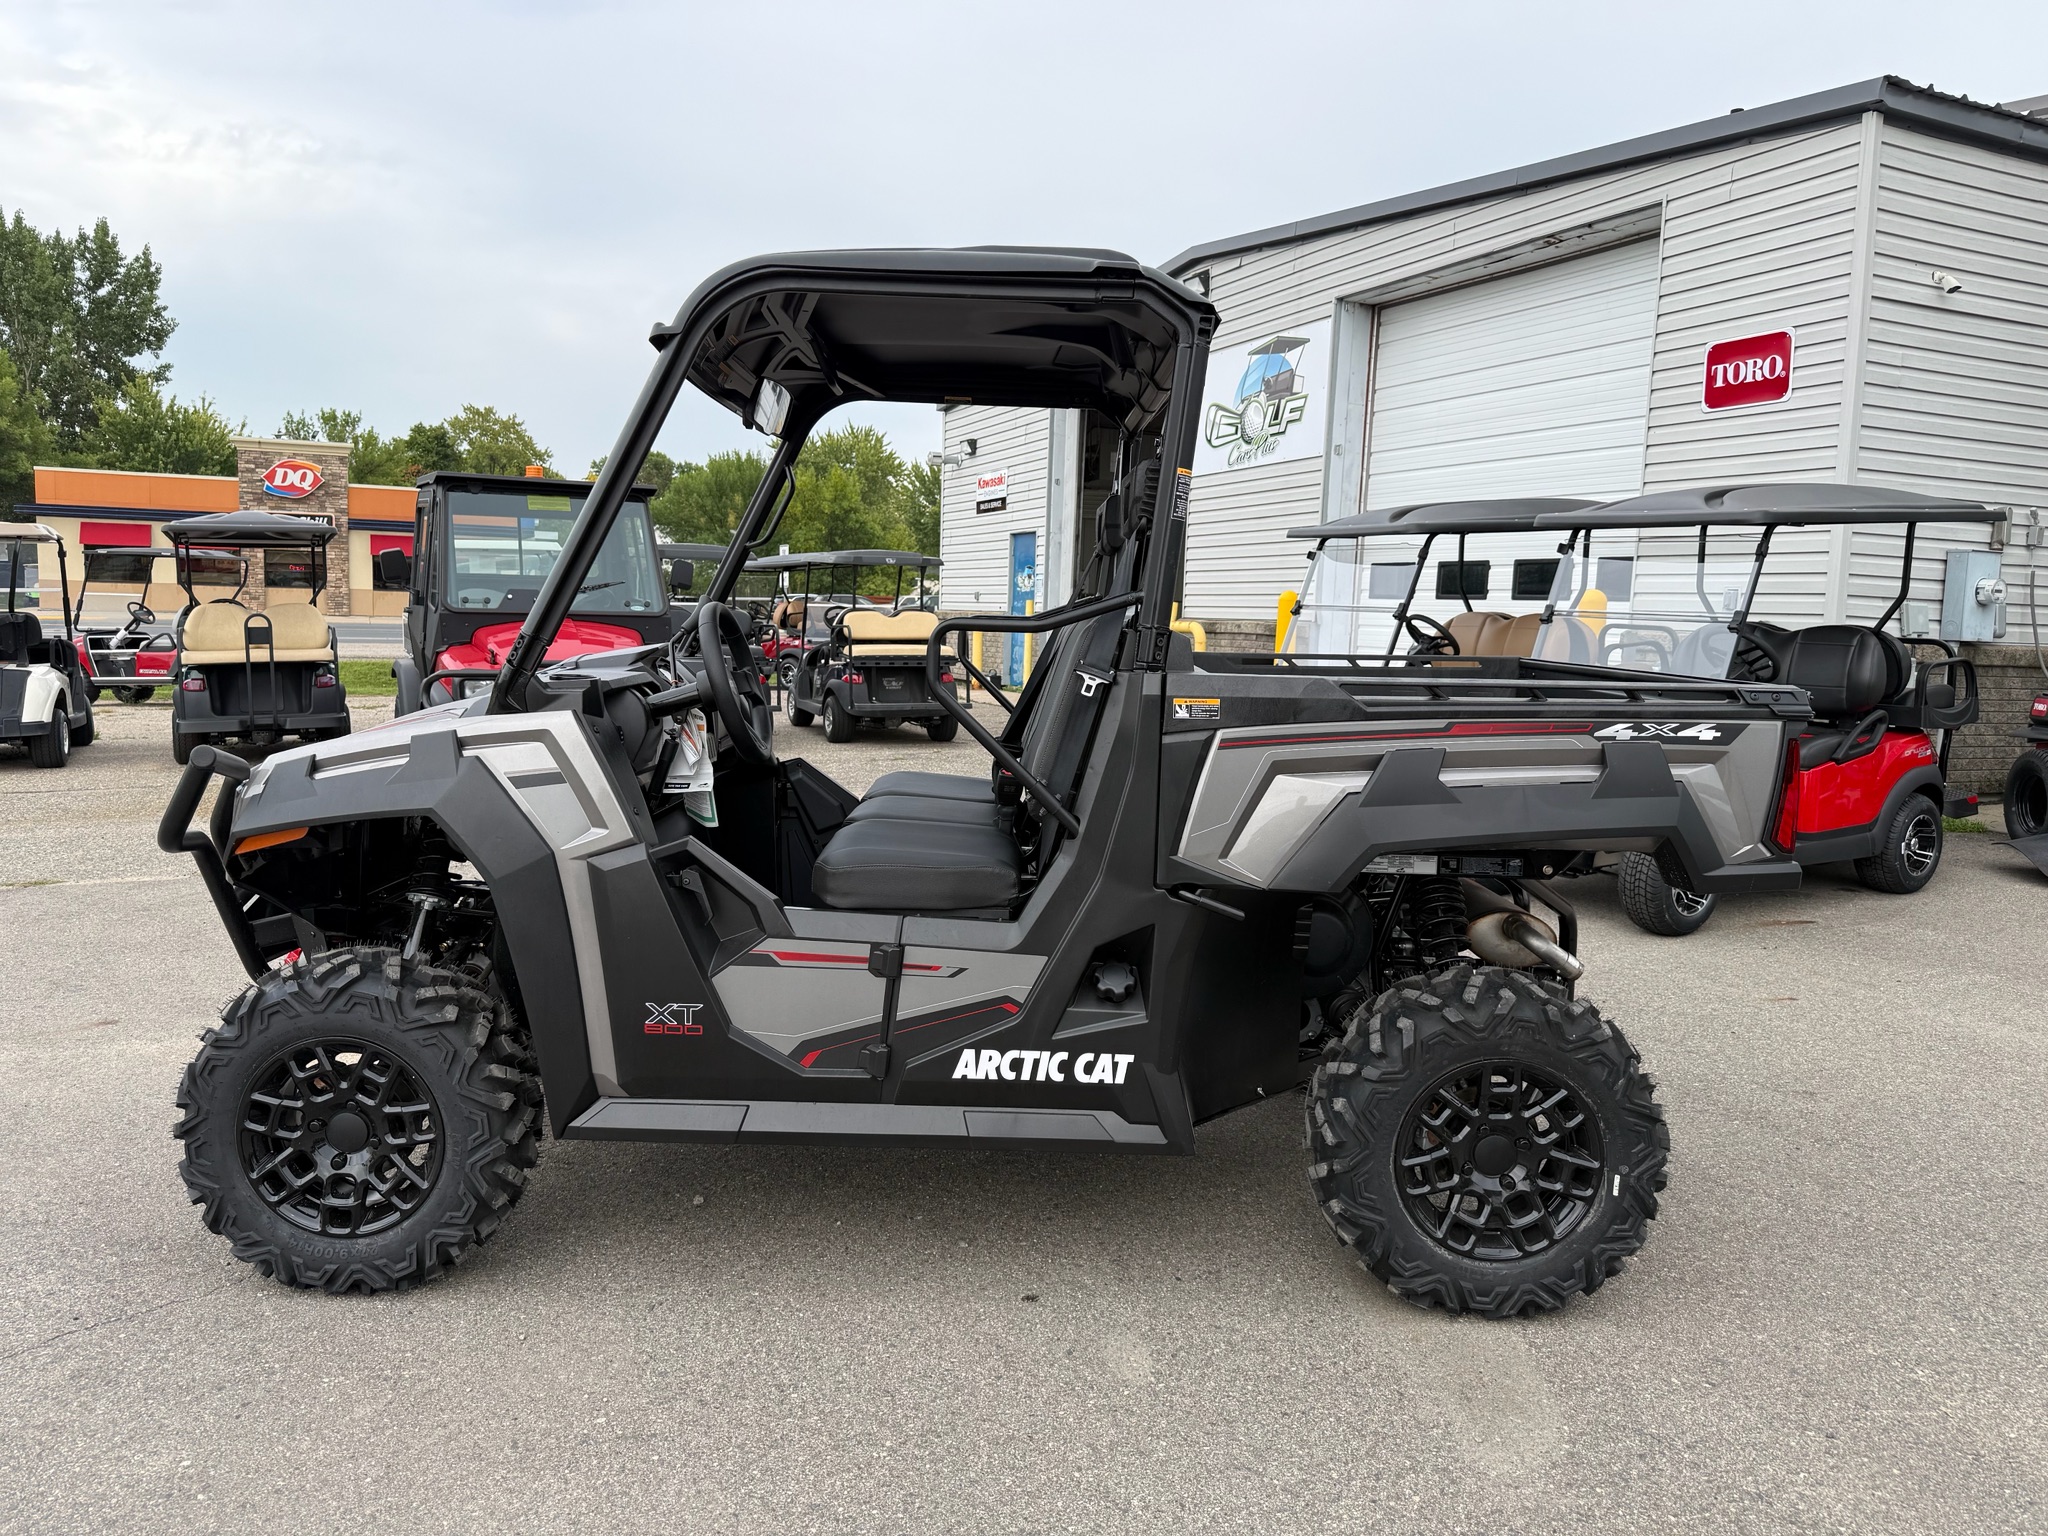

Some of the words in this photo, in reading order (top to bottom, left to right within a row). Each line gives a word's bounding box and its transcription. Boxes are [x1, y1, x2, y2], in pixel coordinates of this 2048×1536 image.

[1711, 354, 1784, 388] TORO
[1205, 393, 1309, 448] GOLF
[272, 467, 315, 490] DQ
[977, 472, 1006, 490] Kawasaki
[645, 1003, 704, 1025] XT
[644, 1024, 703, 1035] 800
[951, 1048, 1069, 1082] ARCTIC
[1073, 1052, 1135, 1085] CAT
